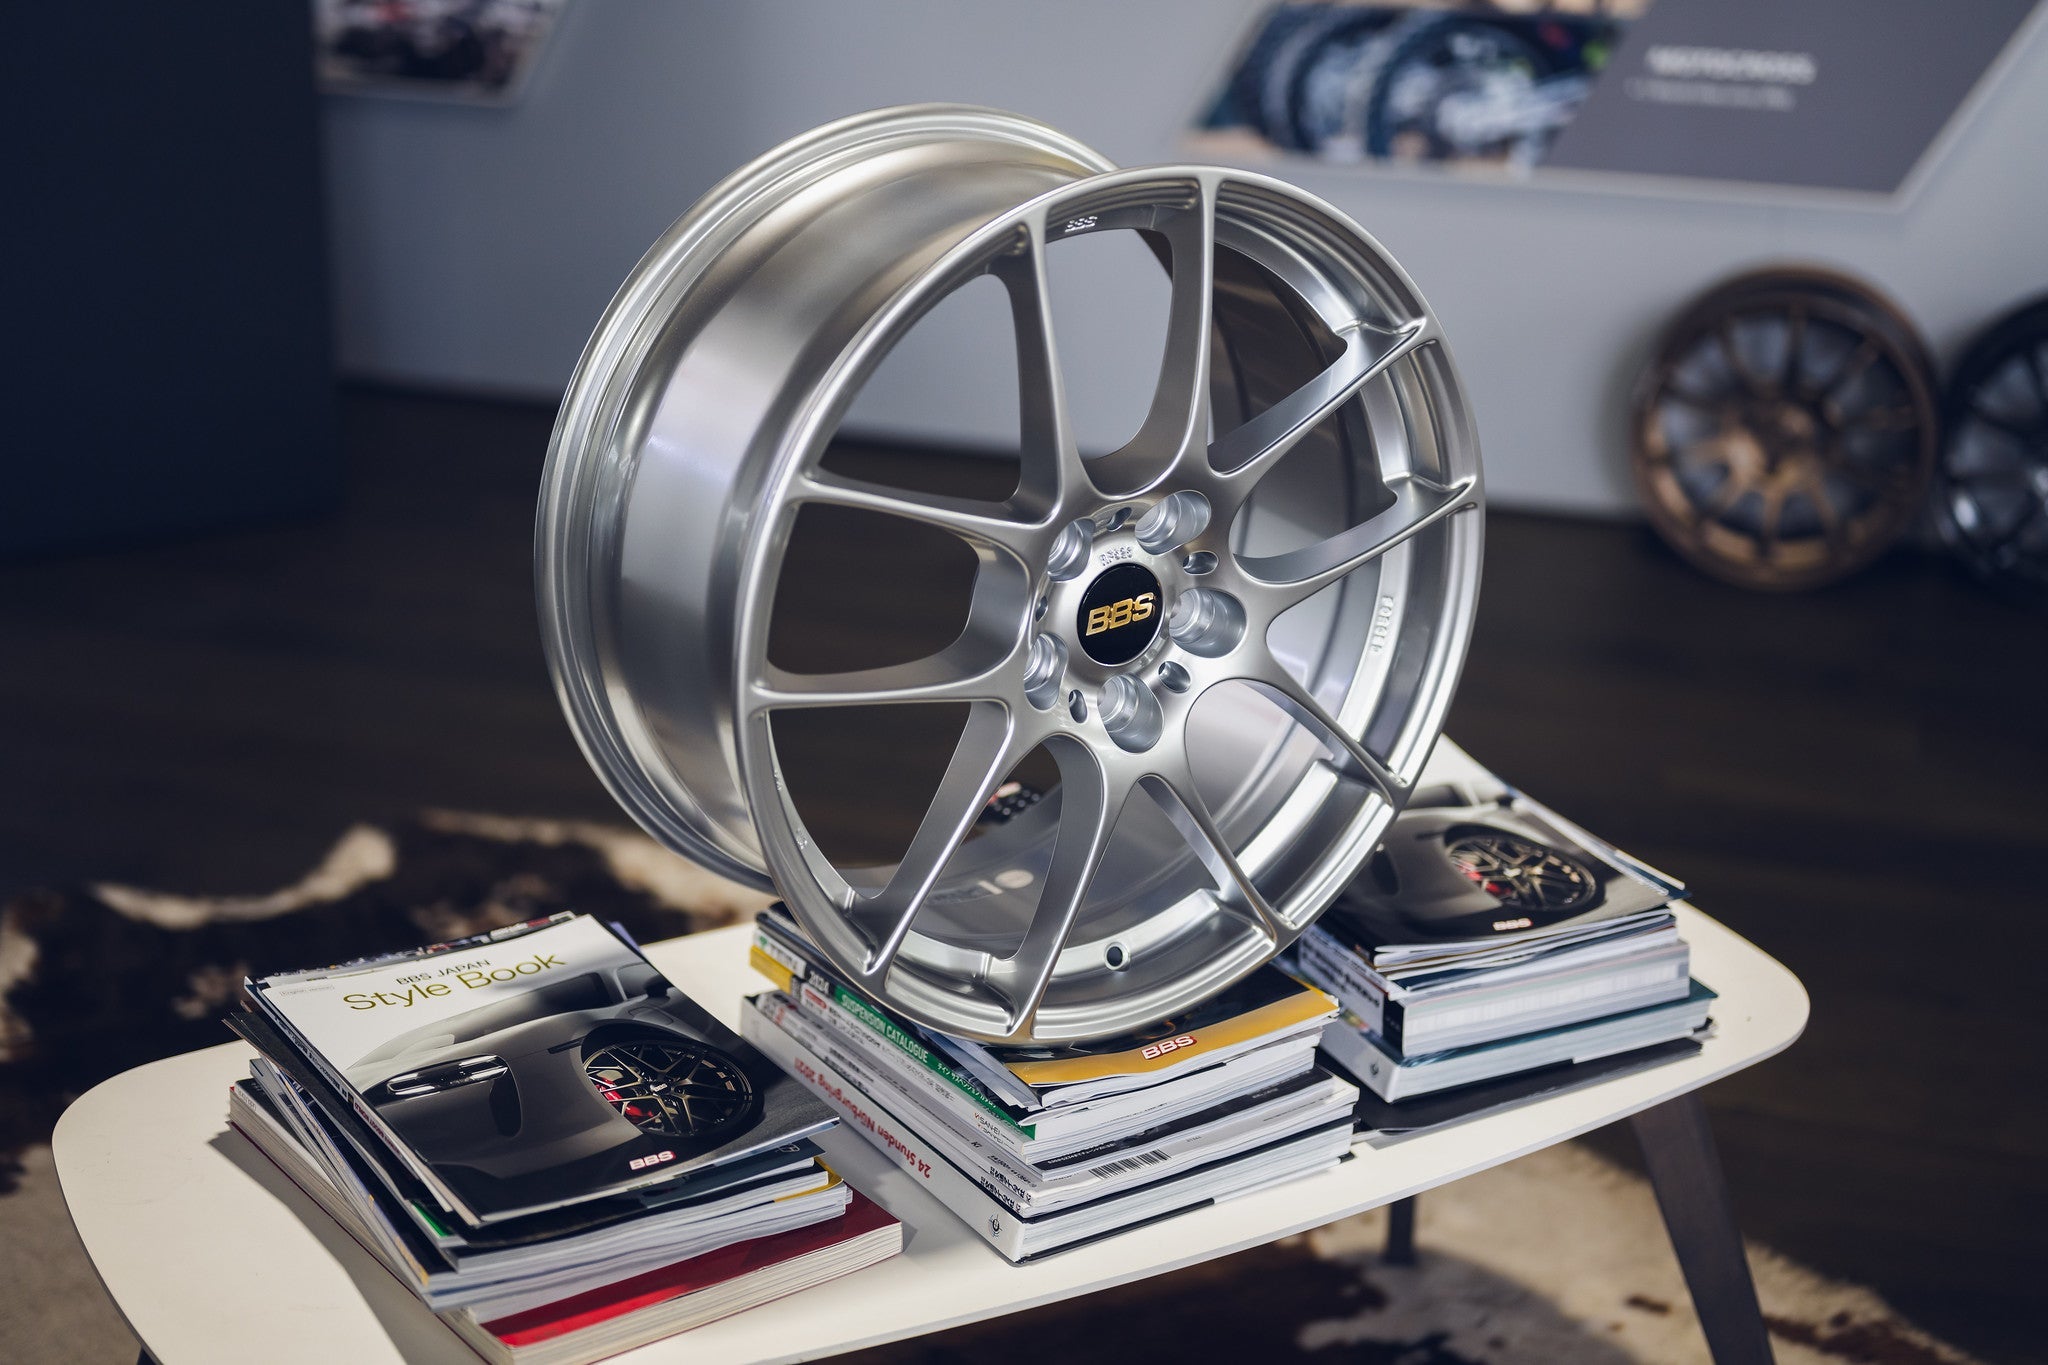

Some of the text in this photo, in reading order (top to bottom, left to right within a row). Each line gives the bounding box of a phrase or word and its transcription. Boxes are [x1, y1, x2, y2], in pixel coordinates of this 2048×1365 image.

[1085, 592, 1155, 636] BBS
[342, 953, 567, 1011] Style Book
[396, 959, 491, 986] BBS JAPAN
[840, 993, 887, 1034] SUSPENSION
[885, 1025, 929, 1064] CATALOGUE
[1141, 1036, 1195, 1060] BBS
[629, 1150, 675, 1171] BBS
[877, 1125, 917, 1166] Stunden
[918, 1158, 932, 1179] 24
